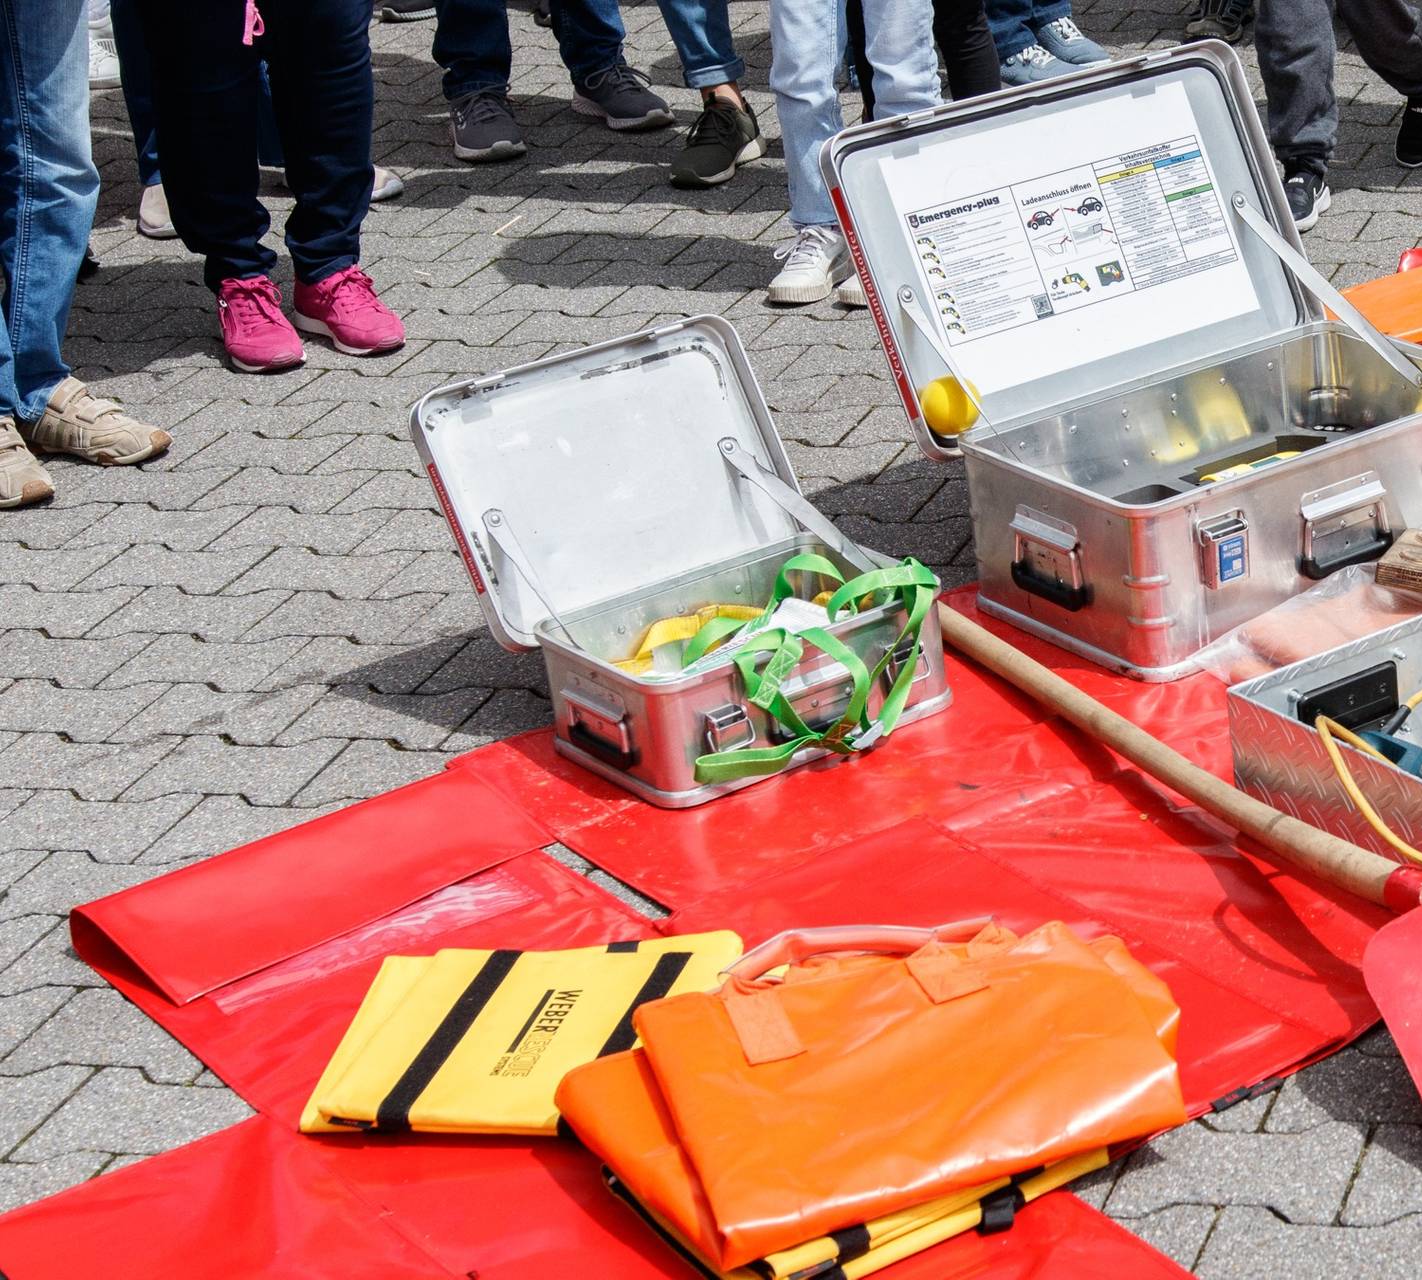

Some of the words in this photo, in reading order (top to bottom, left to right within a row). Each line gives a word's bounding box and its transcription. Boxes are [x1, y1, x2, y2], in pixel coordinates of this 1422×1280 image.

[919, 195, 1000, 225] Emergency-plug
[1021, 187, 1070, 207] Ladeanschluss
[1070, 182, 1092, 193] öffnen
[846, 229, 902, 380] Verkehrsunfallkoffer
[532, 989, 583, 1033] WEBER
